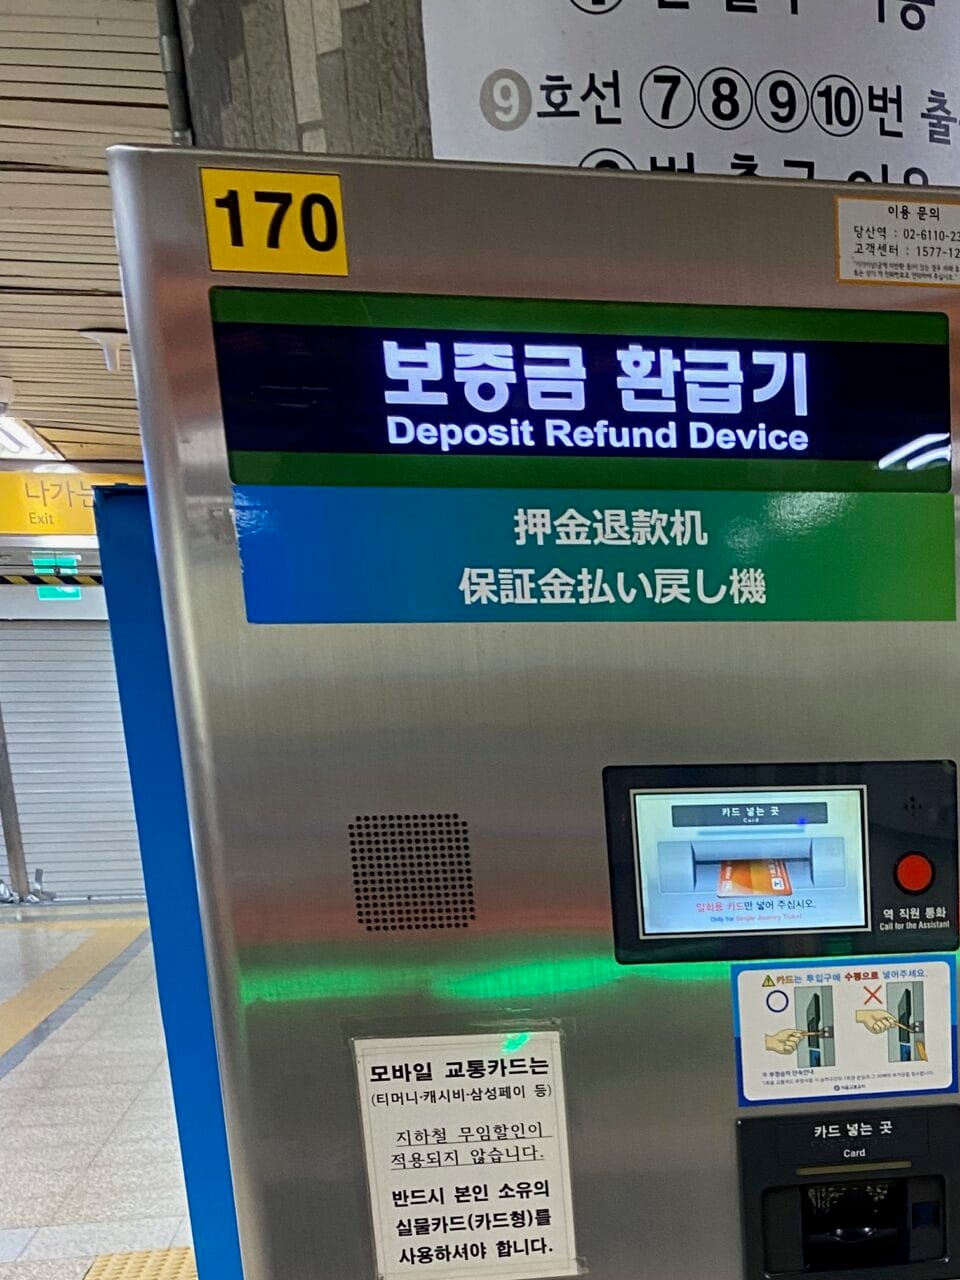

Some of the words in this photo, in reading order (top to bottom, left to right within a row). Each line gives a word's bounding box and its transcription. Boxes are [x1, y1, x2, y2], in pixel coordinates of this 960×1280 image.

[214, 189, 338, 252] 170
[888, 205, 911, 219] 이용
[917, 207, 940, 221] 문의
[854, 225, 886, 239] 당산역
[854, 243, 899, 256] 고객센터
[382, 340, 587, 414] 보증금
[616, 343, 809, 418] 환급기
[387, 415, 535, 452] Deposit
[545, 419, 678, 451] Refund
[690, 422, 809, 452] Device
[29, 512, 54, 524] Exit
[514, 509, 708, 546] 押金退款机
[459, 567, 768, 606] 保証金払い戻し機
[722, 807, 740, 817] 카드
[746, 806, 764, 816] 넣는
[770, 806, 780, 816] 곳
[880, 922, 893, 931] Call
[919, 920, 950, 929] Assistant
[883, 908, 893, 920] 역
[899, 907, 920, 919] 직원
[370, 1061, 433, 1083] 모바일
[445, 1056, 549, 1079] 교통카드는
[534, 1083, 552, 1097] 등)
[396, 1127, 447, 1146] 지하철
[458, 1121, 543, 1143] 무임할인이
[814, 1125, 841, 1139] 카드
[846, 1122, 872, 1137] 넣는
[879, 1121, 893, 1135] 곳
[391, 1150, 459, 1170] 적용되지
[470, 1144, 544, 1165] 않습니다.
[843, 1148, 866, 1159] Card
[392, 1186, 445, 1208] 반드시
[454, 1183, 489, 1203] 본인
[498, 1179, 550, 1199] 소유의
[396, 1208, 552, 1237] 실물카드(카드형)를
[399, 1241, 487, 1265] 사용하셔야
[495, 1237, 553, 1258] 합니다.
